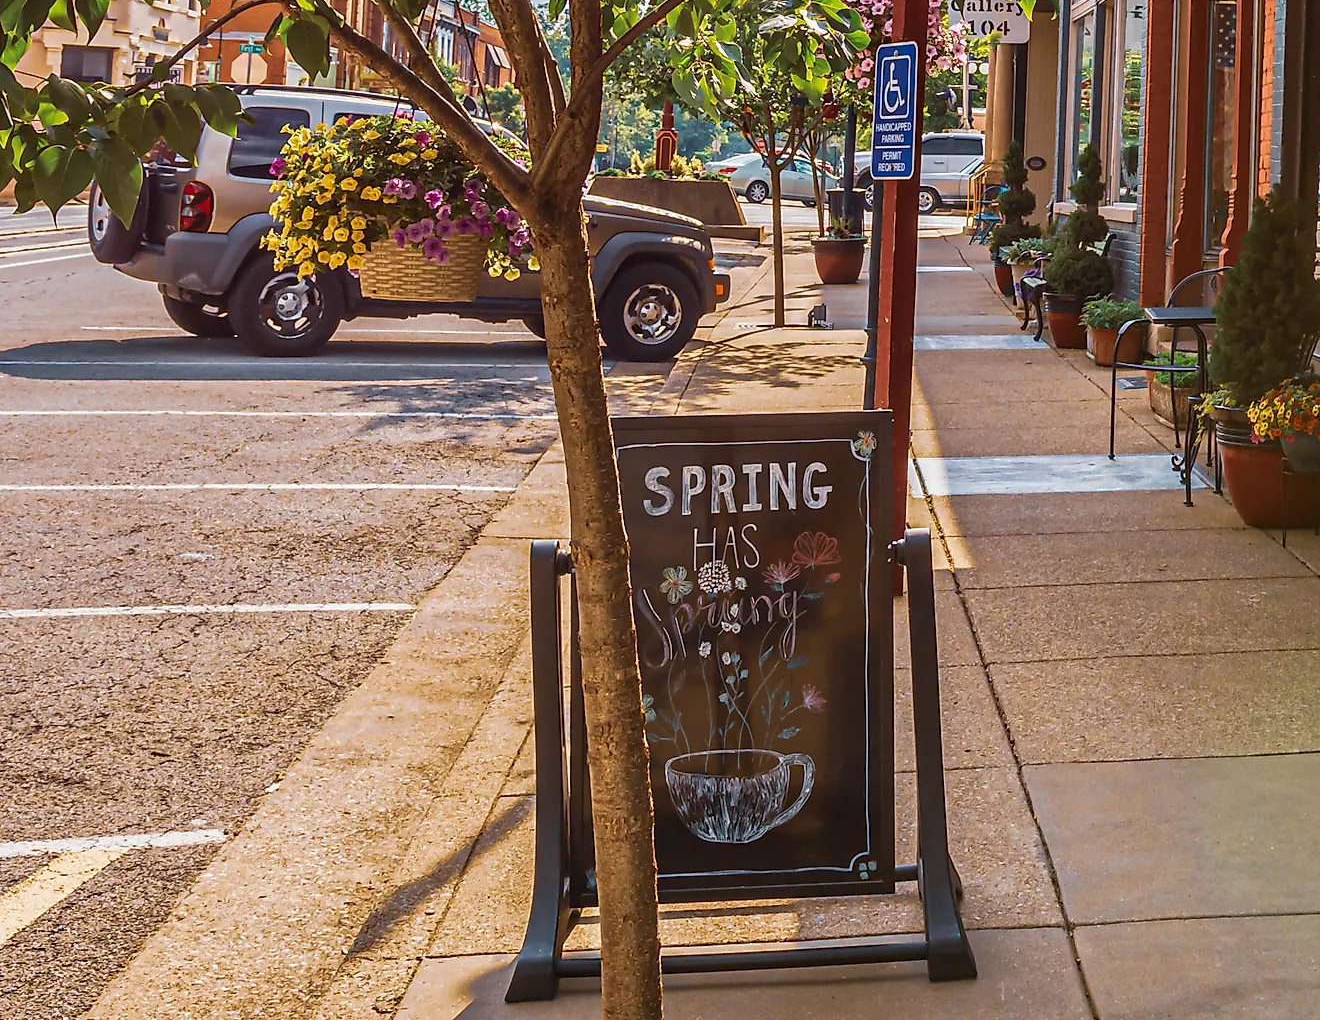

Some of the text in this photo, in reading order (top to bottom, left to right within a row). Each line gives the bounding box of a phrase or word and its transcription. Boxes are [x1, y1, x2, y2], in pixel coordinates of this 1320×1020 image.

[968, 20, 1011, 36] 104
[876, 122, 912, 132] HANDICAPPED
[881, 134, 905, 143] PARKING
[882, 151, 903, 160] PERMIT
[877, 163, 906, 172] REQRED
[642, 461, 833, 517] SPRING
[692, 523, 761, 572] HAS
